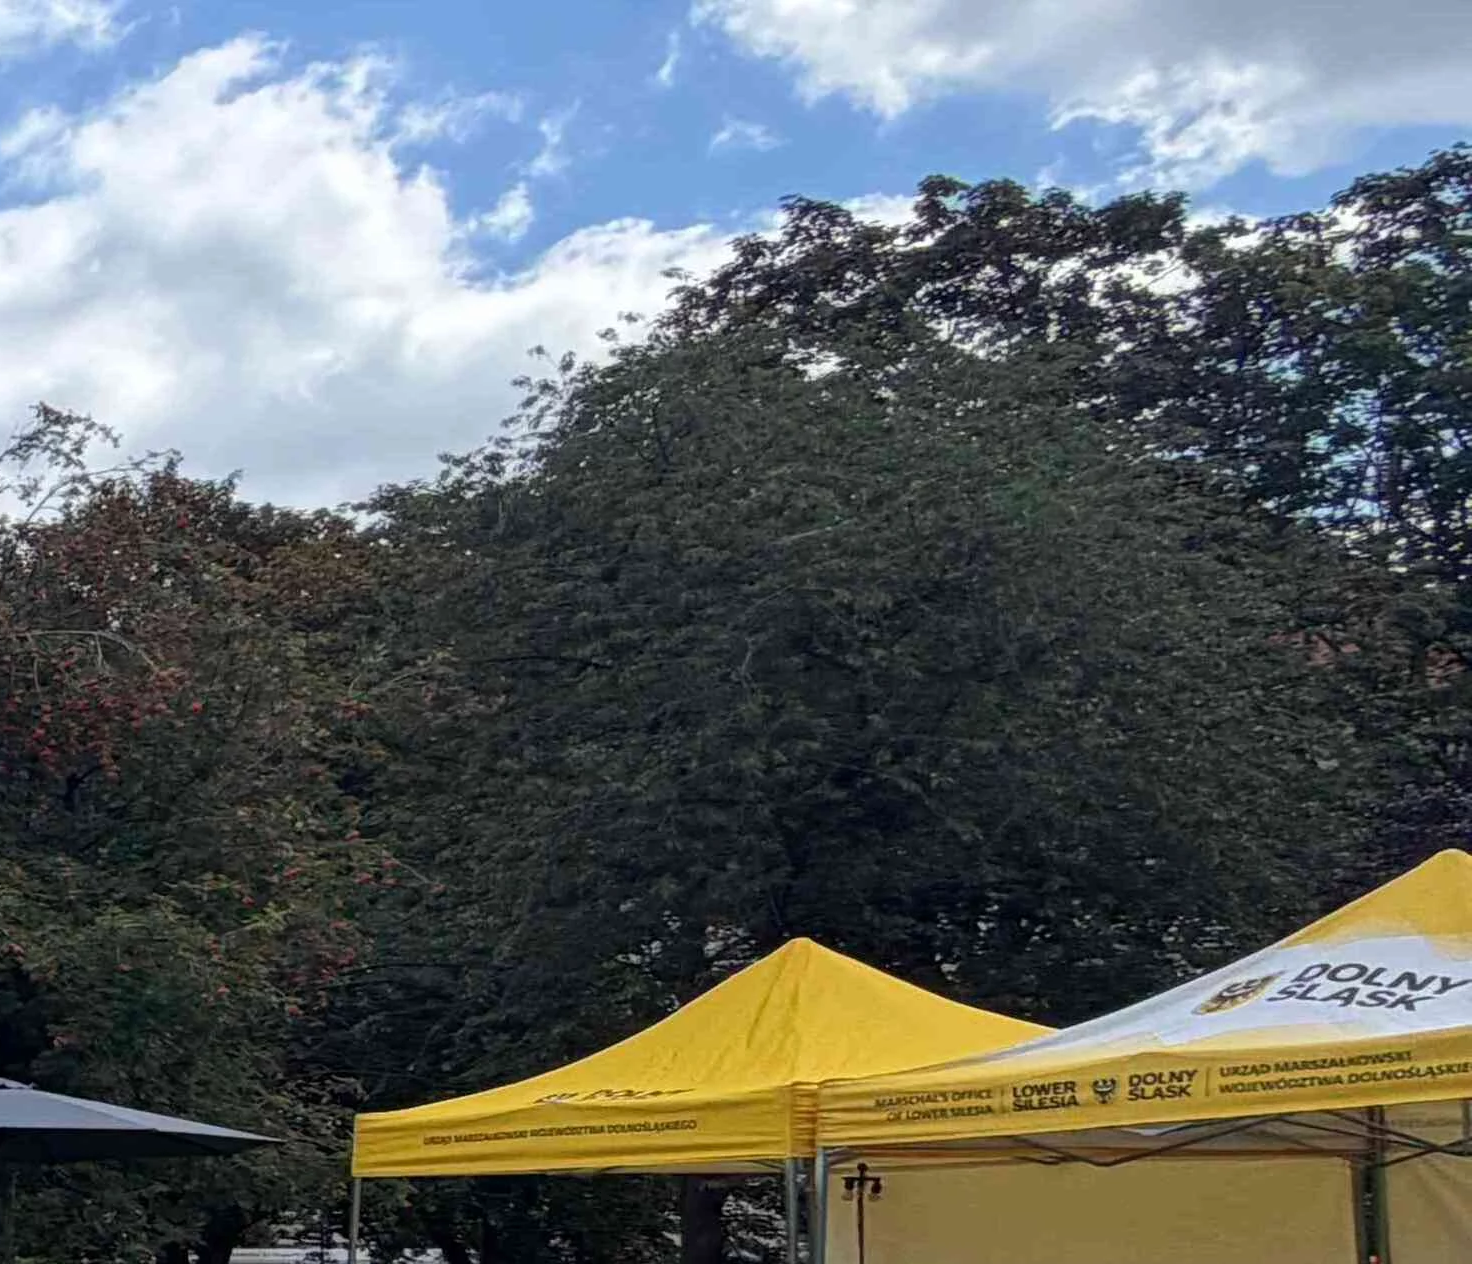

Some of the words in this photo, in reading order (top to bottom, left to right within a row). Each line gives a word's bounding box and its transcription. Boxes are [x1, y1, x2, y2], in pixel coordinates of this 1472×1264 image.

[1290, 962, 1472, 995] DOLNY
[1220, 1063, 1271, 1078] URZĄD
[1274, 1050, 1413, 1074] MARSZAŁKOWSKI
[1128, 1069, 1198, 1088] DOLNY
[1219, 1073, 1344, 1094] WOJEWÓDZTWA
[1012, 1080, 1077, 1099] LOWER
[1012, 1096, 1079, 1113] SILESIA
